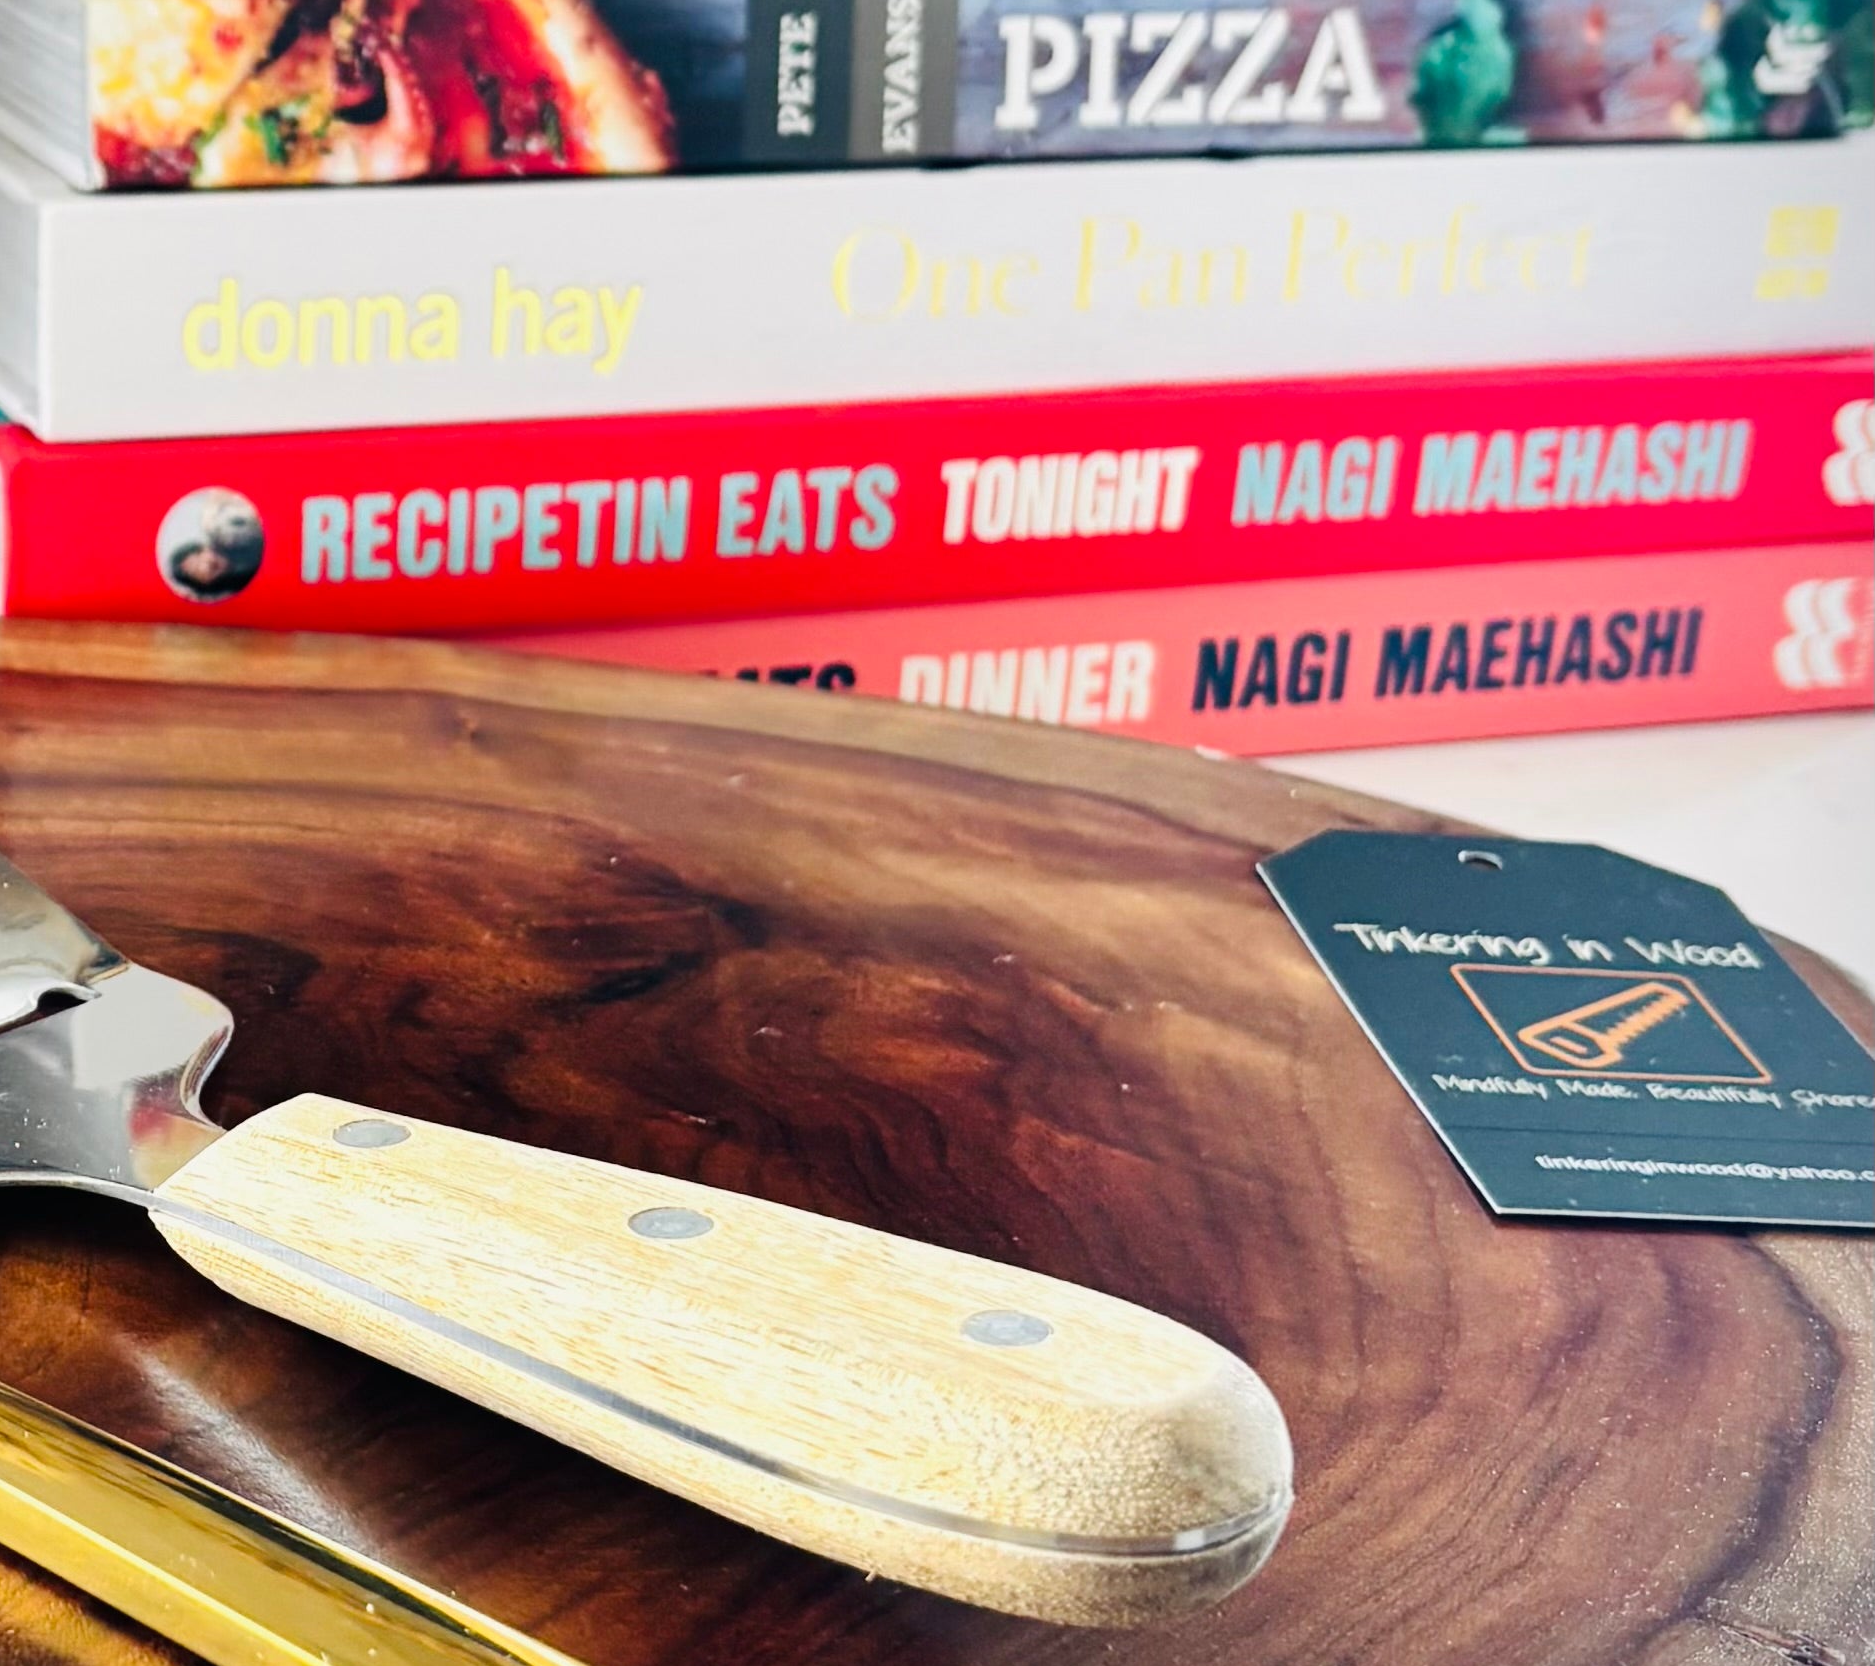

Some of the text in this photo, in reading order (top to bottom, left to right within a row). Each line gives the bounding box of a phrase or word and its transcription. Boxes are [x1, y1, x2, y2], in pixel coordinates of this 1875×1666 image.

[777, 10, 817, 137] PETE
[993, 7, 1387, 130] PIZZA
[182, 267, 643, 375] donna hay
[830, 202, 1592, 323] One Pan Perfect
[302, 419, 1752, 584] RECIPETIN EATS TONIGHT NAGI MAEHASHI
[899, 608, 1702, 725] DINNER NAGI MAEHASHI
[1333, 922, 1763, 969] Tinkering in Wood
[1432, 1074, 1548, 1100] Mindfully
